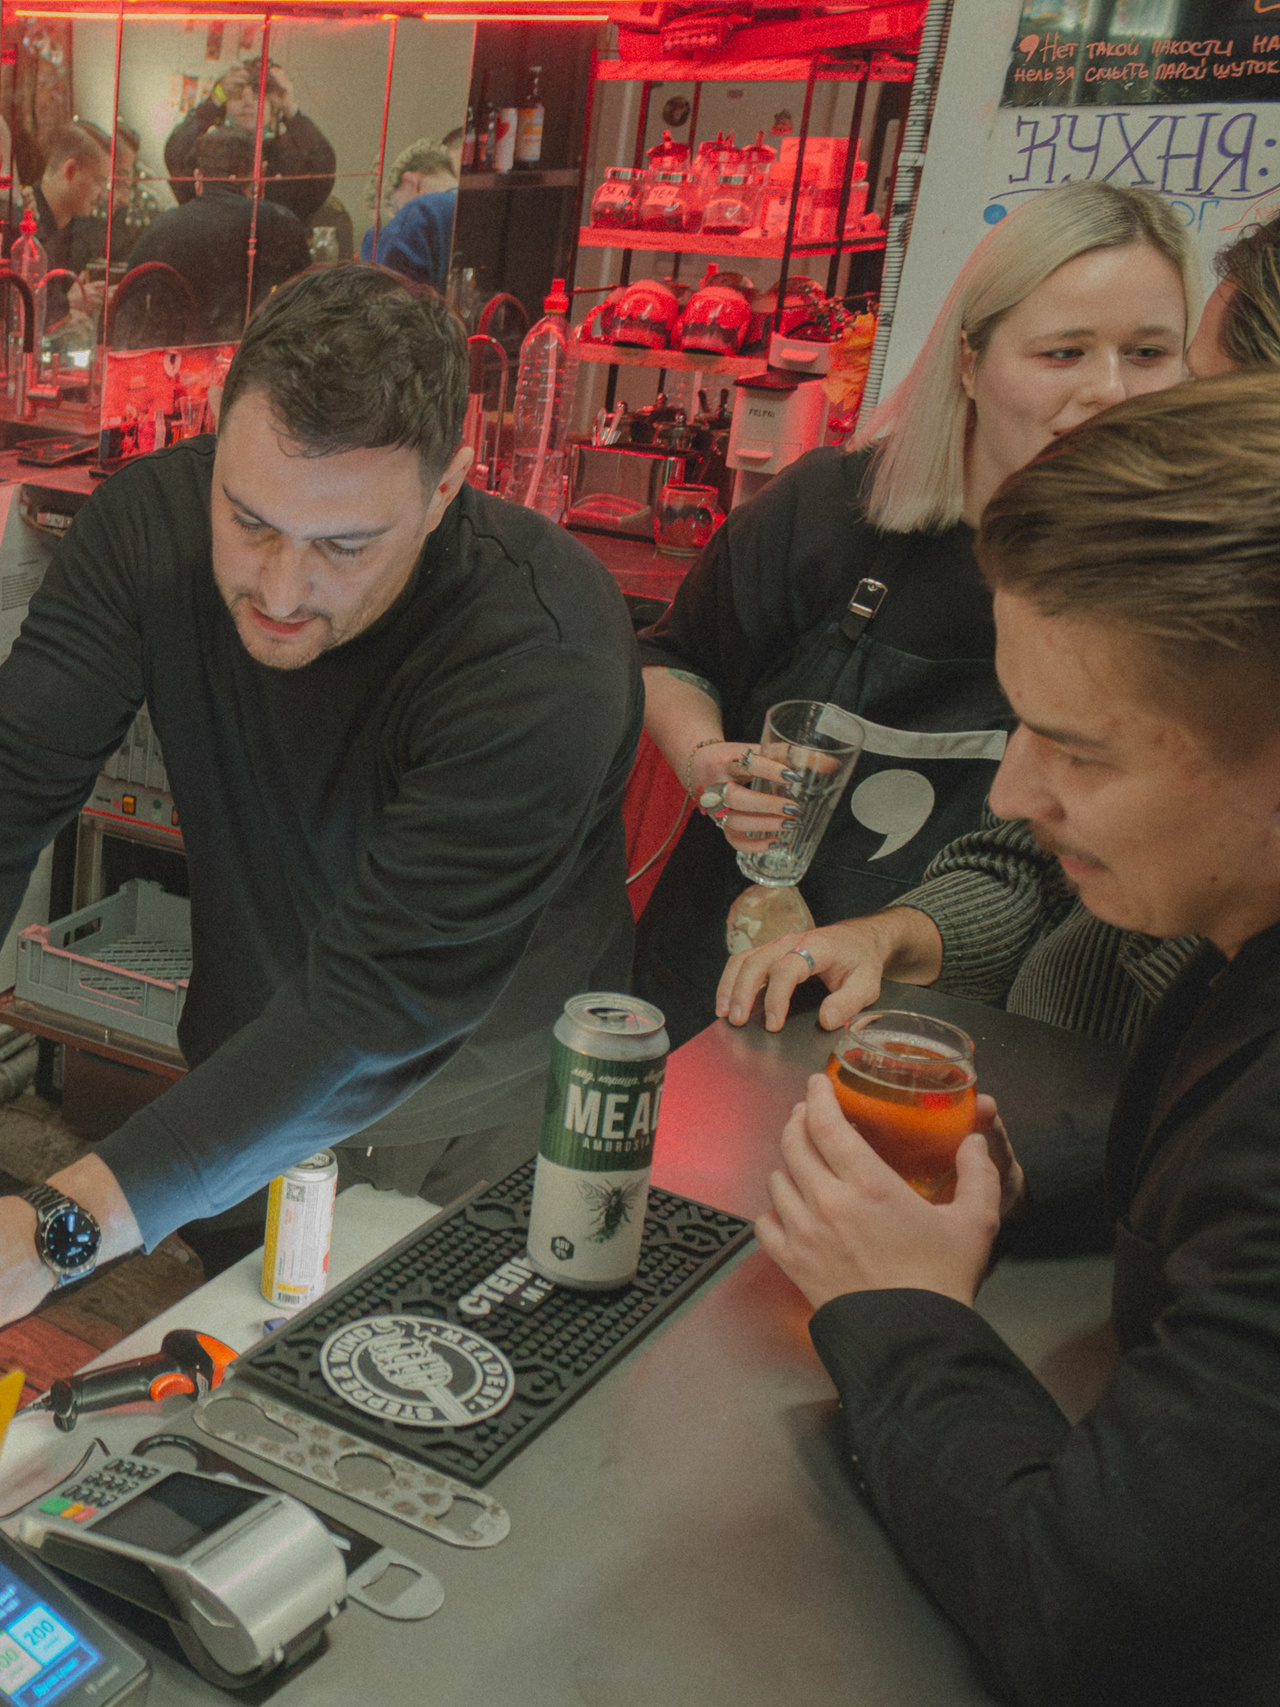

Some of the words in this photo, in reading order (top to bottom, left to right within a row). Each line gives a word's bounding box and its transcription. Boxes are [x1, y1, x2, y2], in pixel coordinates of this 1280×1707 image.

[327, 1326, 373, 1364] WIND
[440, 1328, 507, 1410] MEADERY
[23, 1619, 55, 1646] 200
